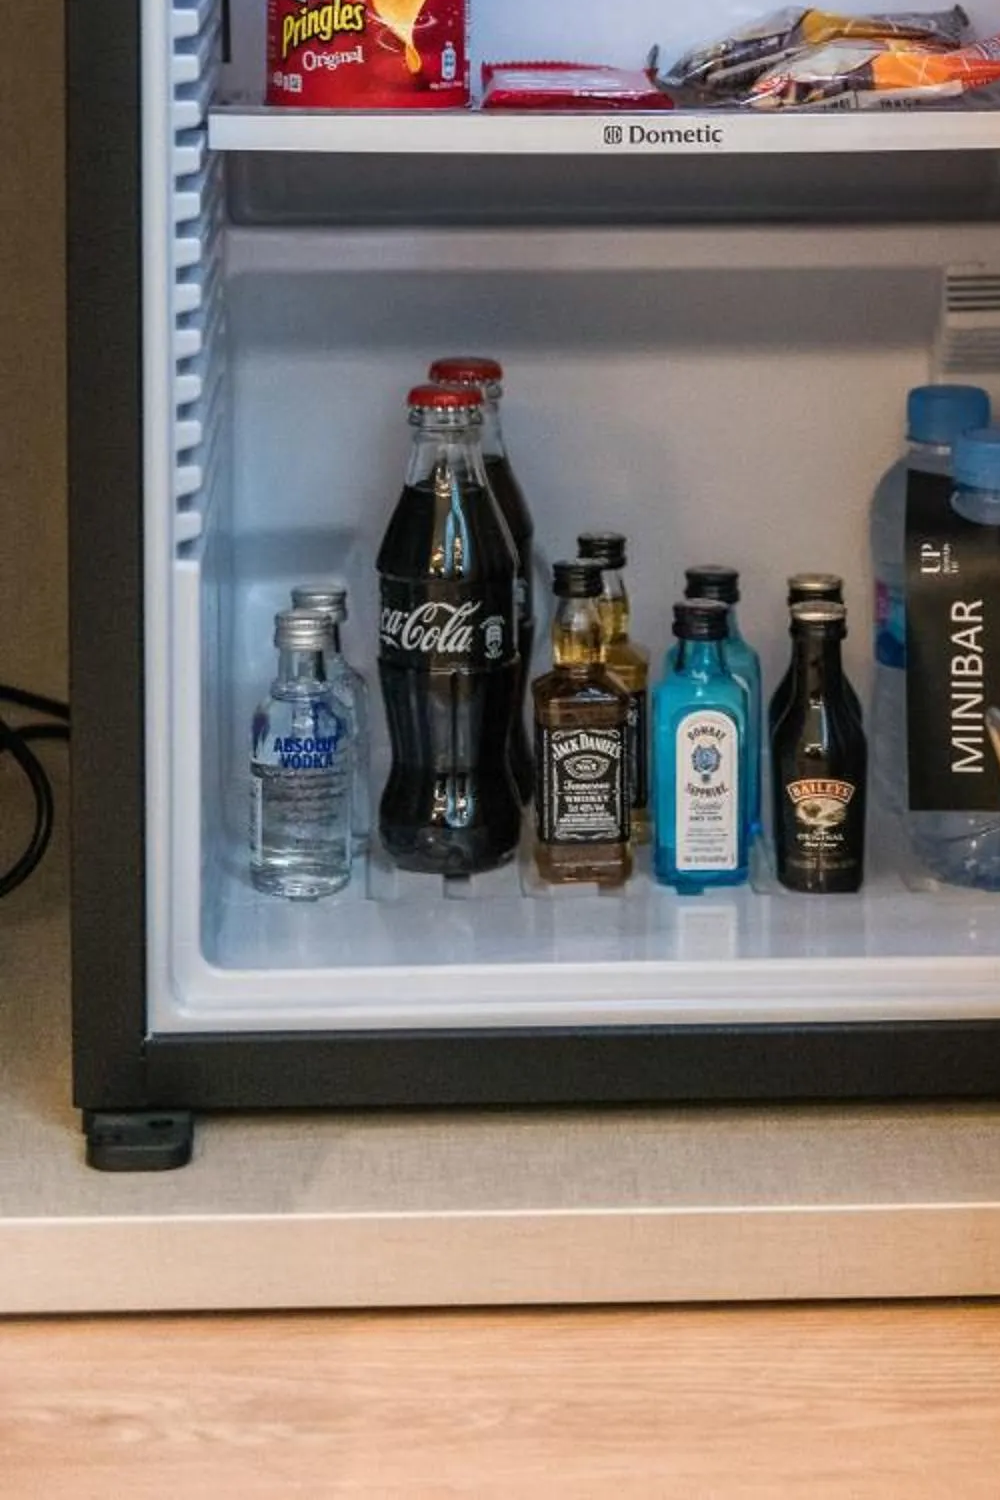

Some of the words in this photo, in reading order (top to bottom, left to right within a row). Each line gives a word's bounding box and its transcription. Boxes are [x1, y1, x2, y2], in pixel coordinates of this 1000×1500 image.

[302, 45, 365, 71] Original
[629, 125, 723, 144] Dometic
[381, 600, 482, 653] ca-Cola
[951, 599, 984, 773] MINIBAR
[273, 737, 338, 753] ABSOLUT
[552, 738, 580, 761] JACK
[280, 752, 334, 769] VODKA
[791, 783, 849, 798] BAILEYS
